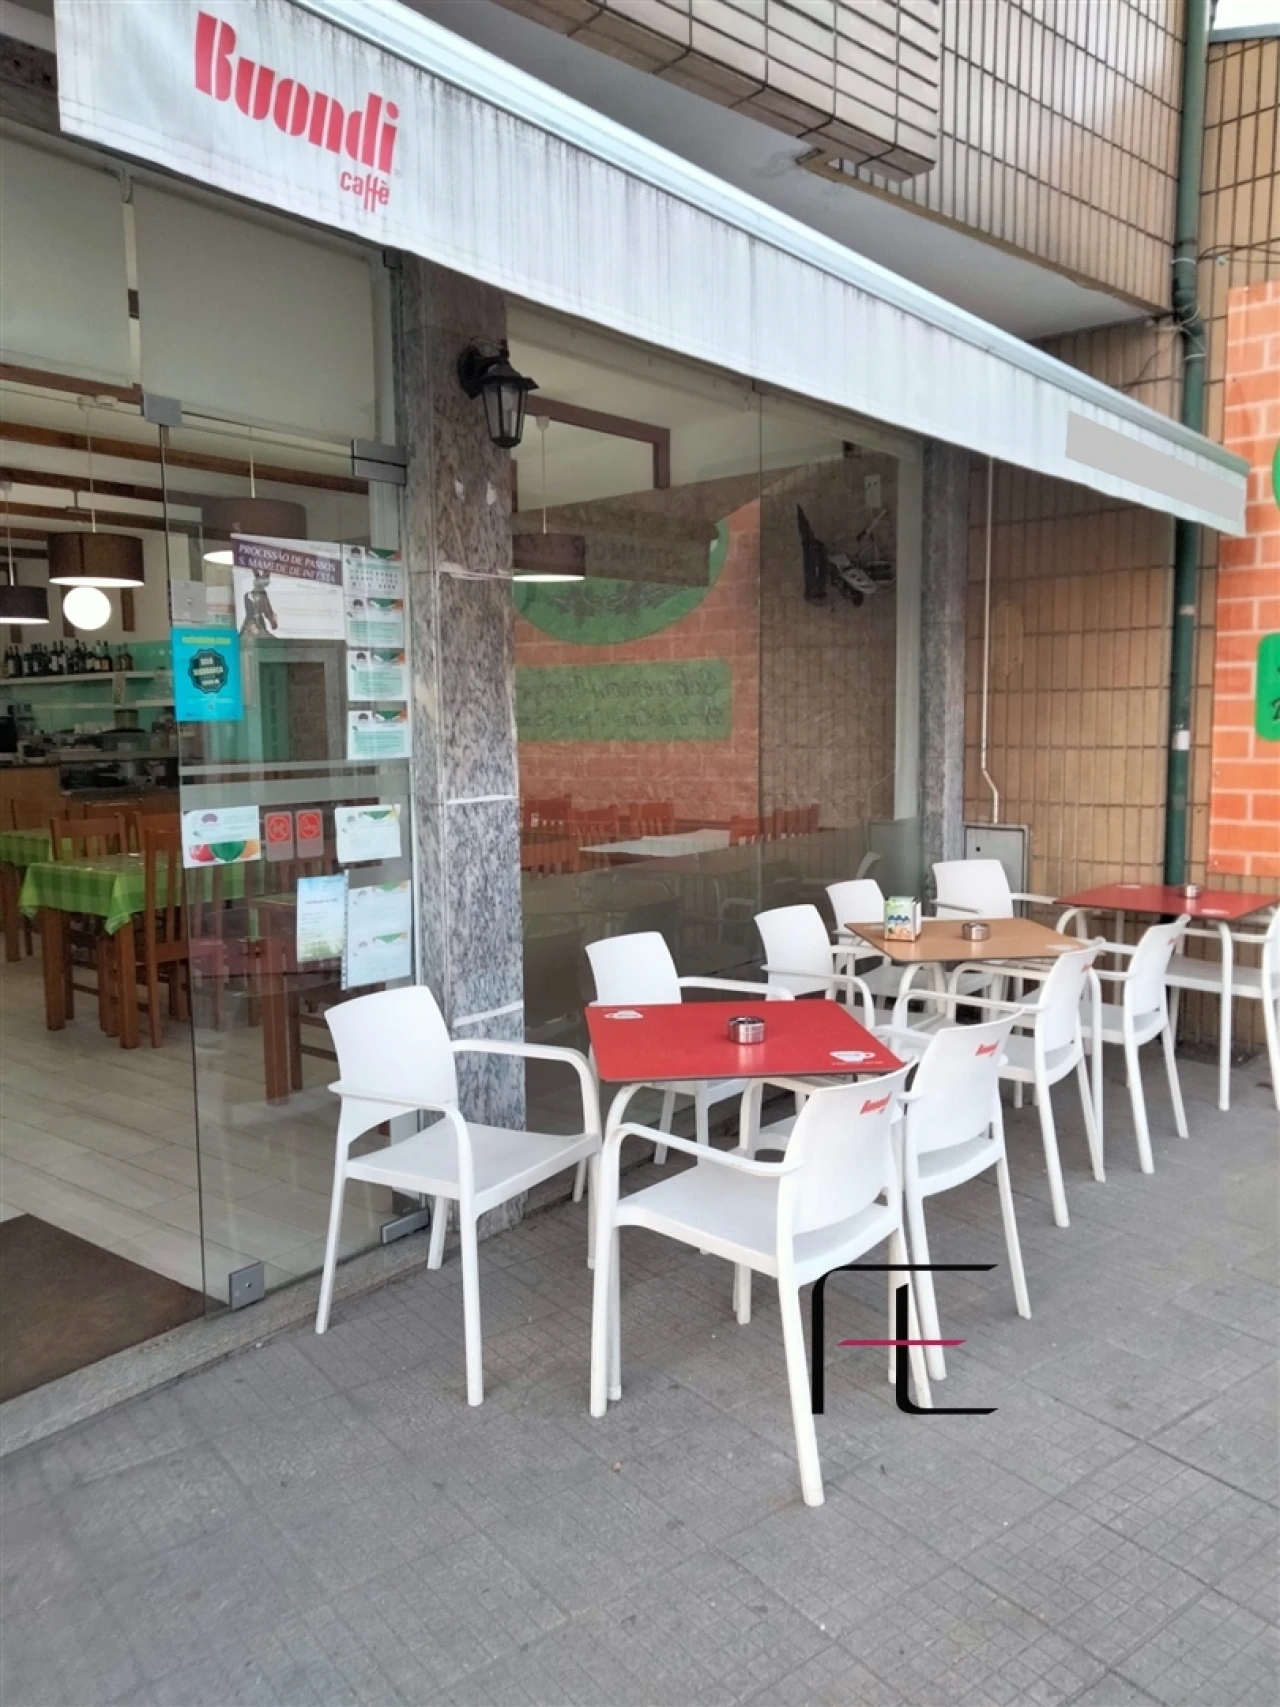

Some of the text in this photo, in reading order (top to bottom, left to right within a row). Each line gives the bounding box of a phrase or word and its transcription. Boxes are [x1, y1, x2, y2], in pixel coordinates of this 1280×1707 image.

[194, 10, 399, 176] Buondi
[339, 171, 390, 213] caffè
[290, 553, 304, 566] DE
[304, 557, 336, 572] PASSOS
